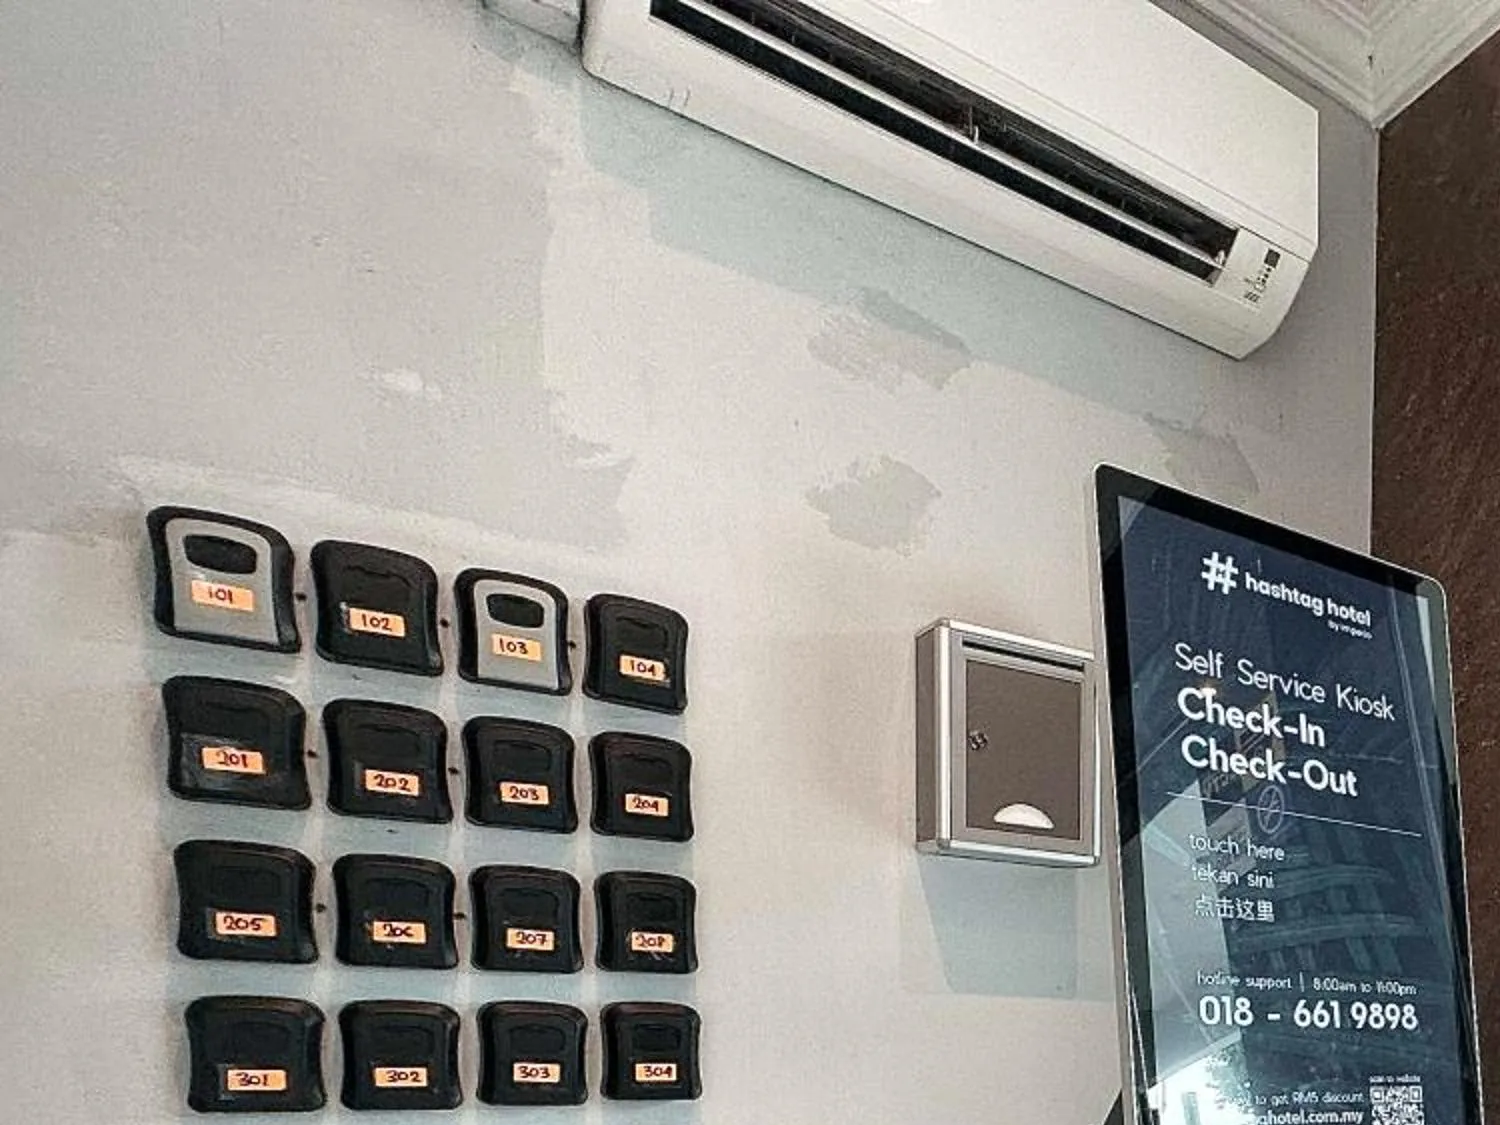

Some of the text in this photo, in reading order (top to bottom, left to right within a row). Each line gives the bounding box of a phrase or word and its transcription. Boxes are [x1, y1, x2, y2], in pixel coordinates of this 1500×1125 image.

[207, 588, 234, 604] 101
[1245, 571, 1324, 617] hashtag
[1327, 598, 1371, 627] hotel
[360, 613, 390, 631] 102
[498, 638, 529, 655] 103
[1175, 642, 1395, 721] Self Service Kiosk
[1177, 686, 1326, 747] Check-In
[217, 750, 249, 769] 201
[1181, 734, 1358, 798] Check-Out
[373, 774, 411, 791] 202
[509, 785, 540, 802] 203
[1188, 834, 1285, 861] touch here
[1191, 862, 1274, 889] tekan sini
[1195, 893, 1275, 922] 点击这里
[223, 915, 262, 933] 205
[516, 931, 547, 946] 207
[1197, 971, 1240, 987] hotline
[1246, 976, 1292, 990] support
[1313, 977, 1357, 993] 8:00am
[1361, 981, 1371, 993] to
[1200, 995, 1254, 1027] 018
[1293, 999, 1341, 1029] 661
[1350, 1001, 1418, 1031] 9898
[236, 1071, 270, 1088] 301
[387, 1069, 421, 1083] 302
[519, 1065, 550, 1079] 303
